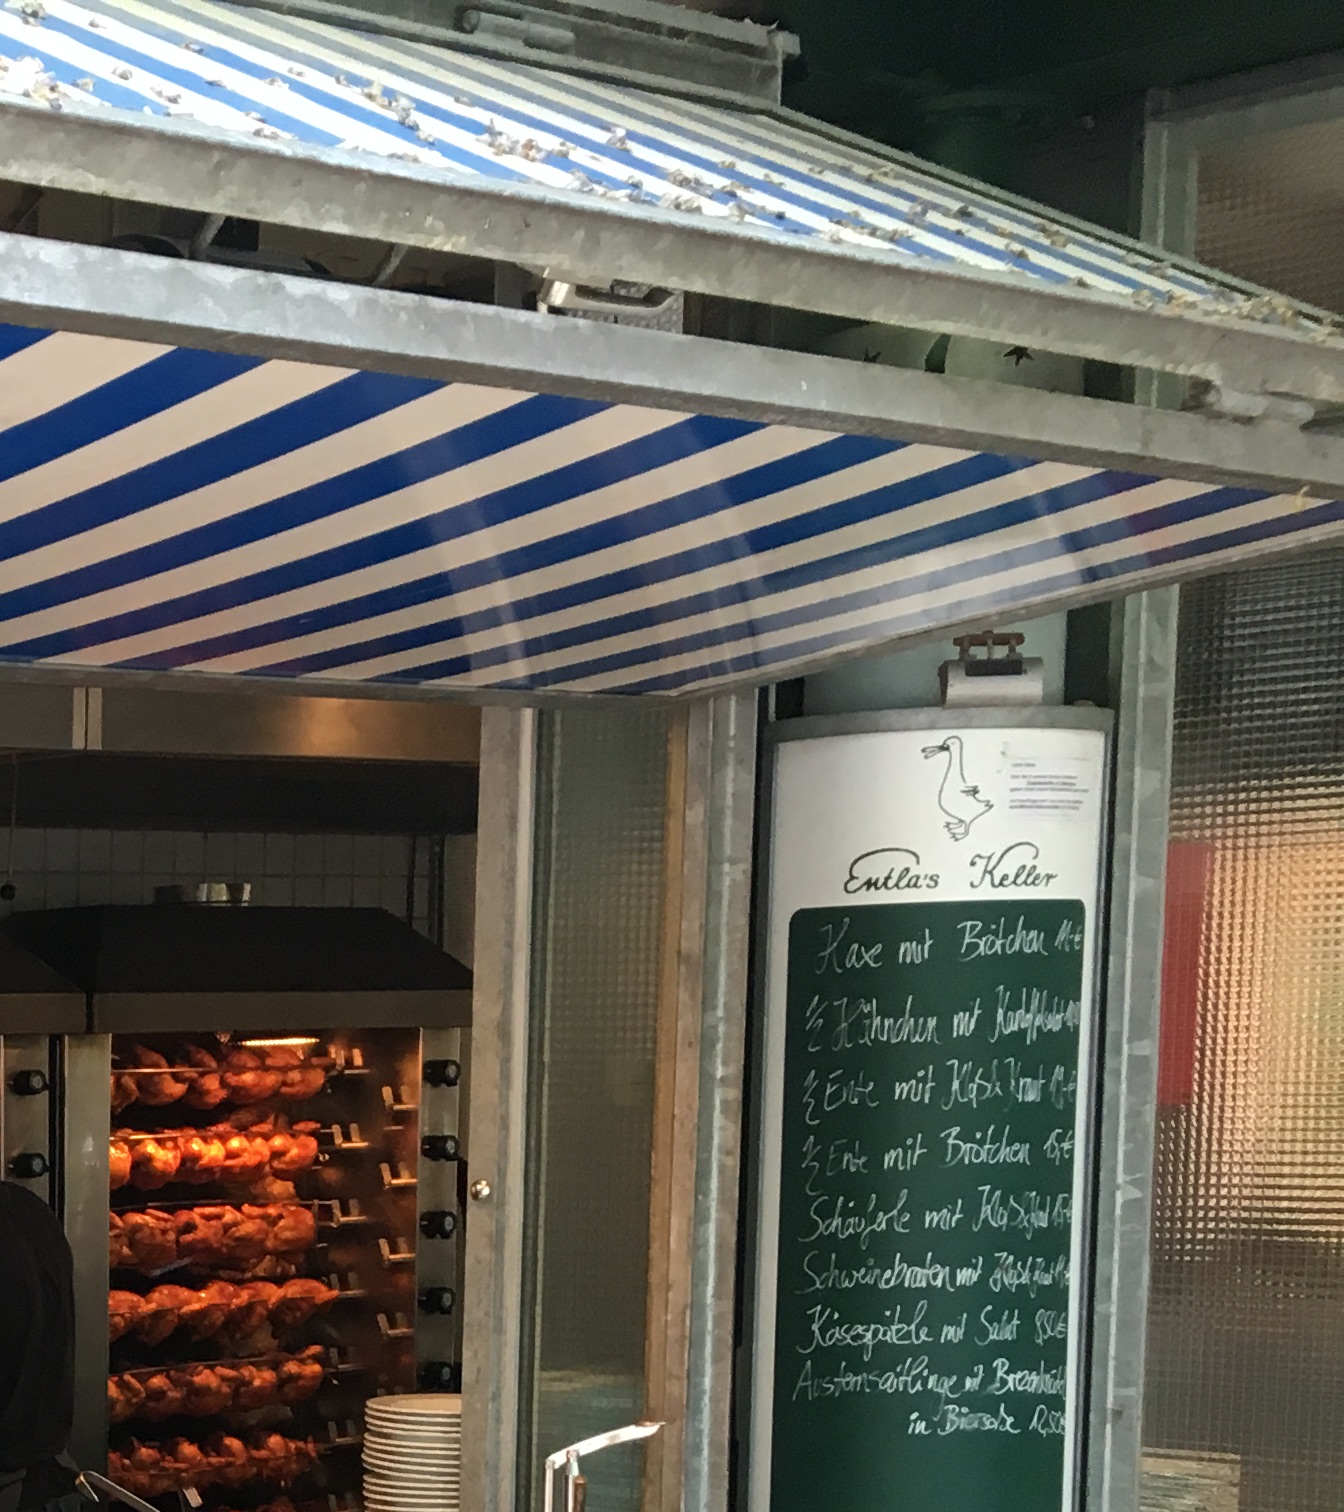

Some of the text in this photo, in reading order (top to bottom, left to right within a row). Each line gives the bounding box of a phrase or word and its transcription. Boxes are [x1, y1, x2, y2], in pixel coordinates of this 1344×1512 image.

[843, 841, 1060, 895] Entla's Keller
[898, 928, 934, 964] mit
[956, 915, 1049, 962] Brötchen
[831, 994, 943, 1051] Hähnchen
[952, 997, 982, 1039] mit
[823, 1069, 880, 1111] Ente
[894, 1064, 935, 1104] mit
[826, 1139, 869, 1176] Ente
[883, 1133, 928, 1172] mit
[940, 1125, 1031, 1168] Brötchen
[925, 1198, 964, 1232] mit
[956, 1256, 984, 1287] mit
[941, 1312, 968, 1344] mit
[908, 1411, 932, 1435] in
